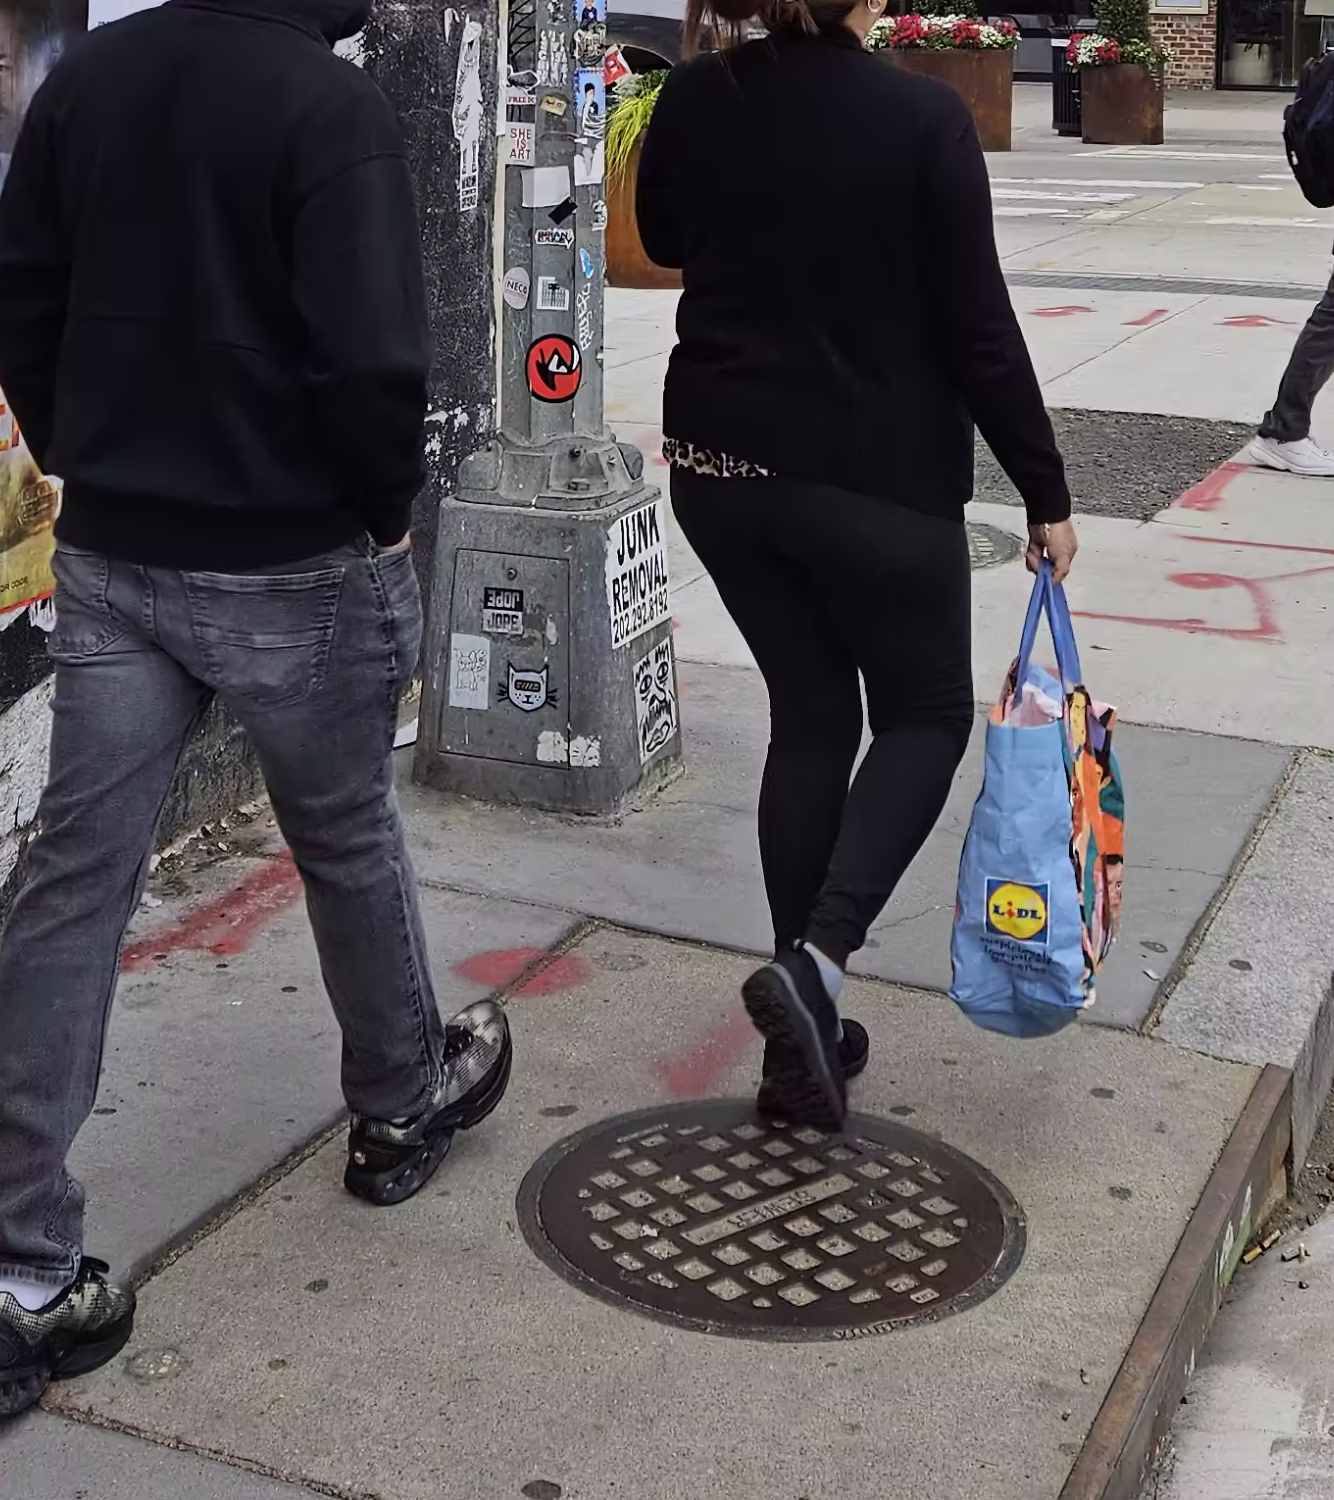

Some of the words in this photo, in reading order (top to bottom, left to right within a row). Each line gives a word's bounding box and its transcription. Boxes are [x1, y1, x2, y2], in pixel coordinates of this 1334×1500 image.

[510, 128, 532, 140] SHE
[517, 138, 526, 149] IS
[509, 149, 531, 160] ART
[617, 502, 661, 566] JUNK
[612, 550, 668, 616] REMOVAL
[992, 900, 1042, 921] LIDL
